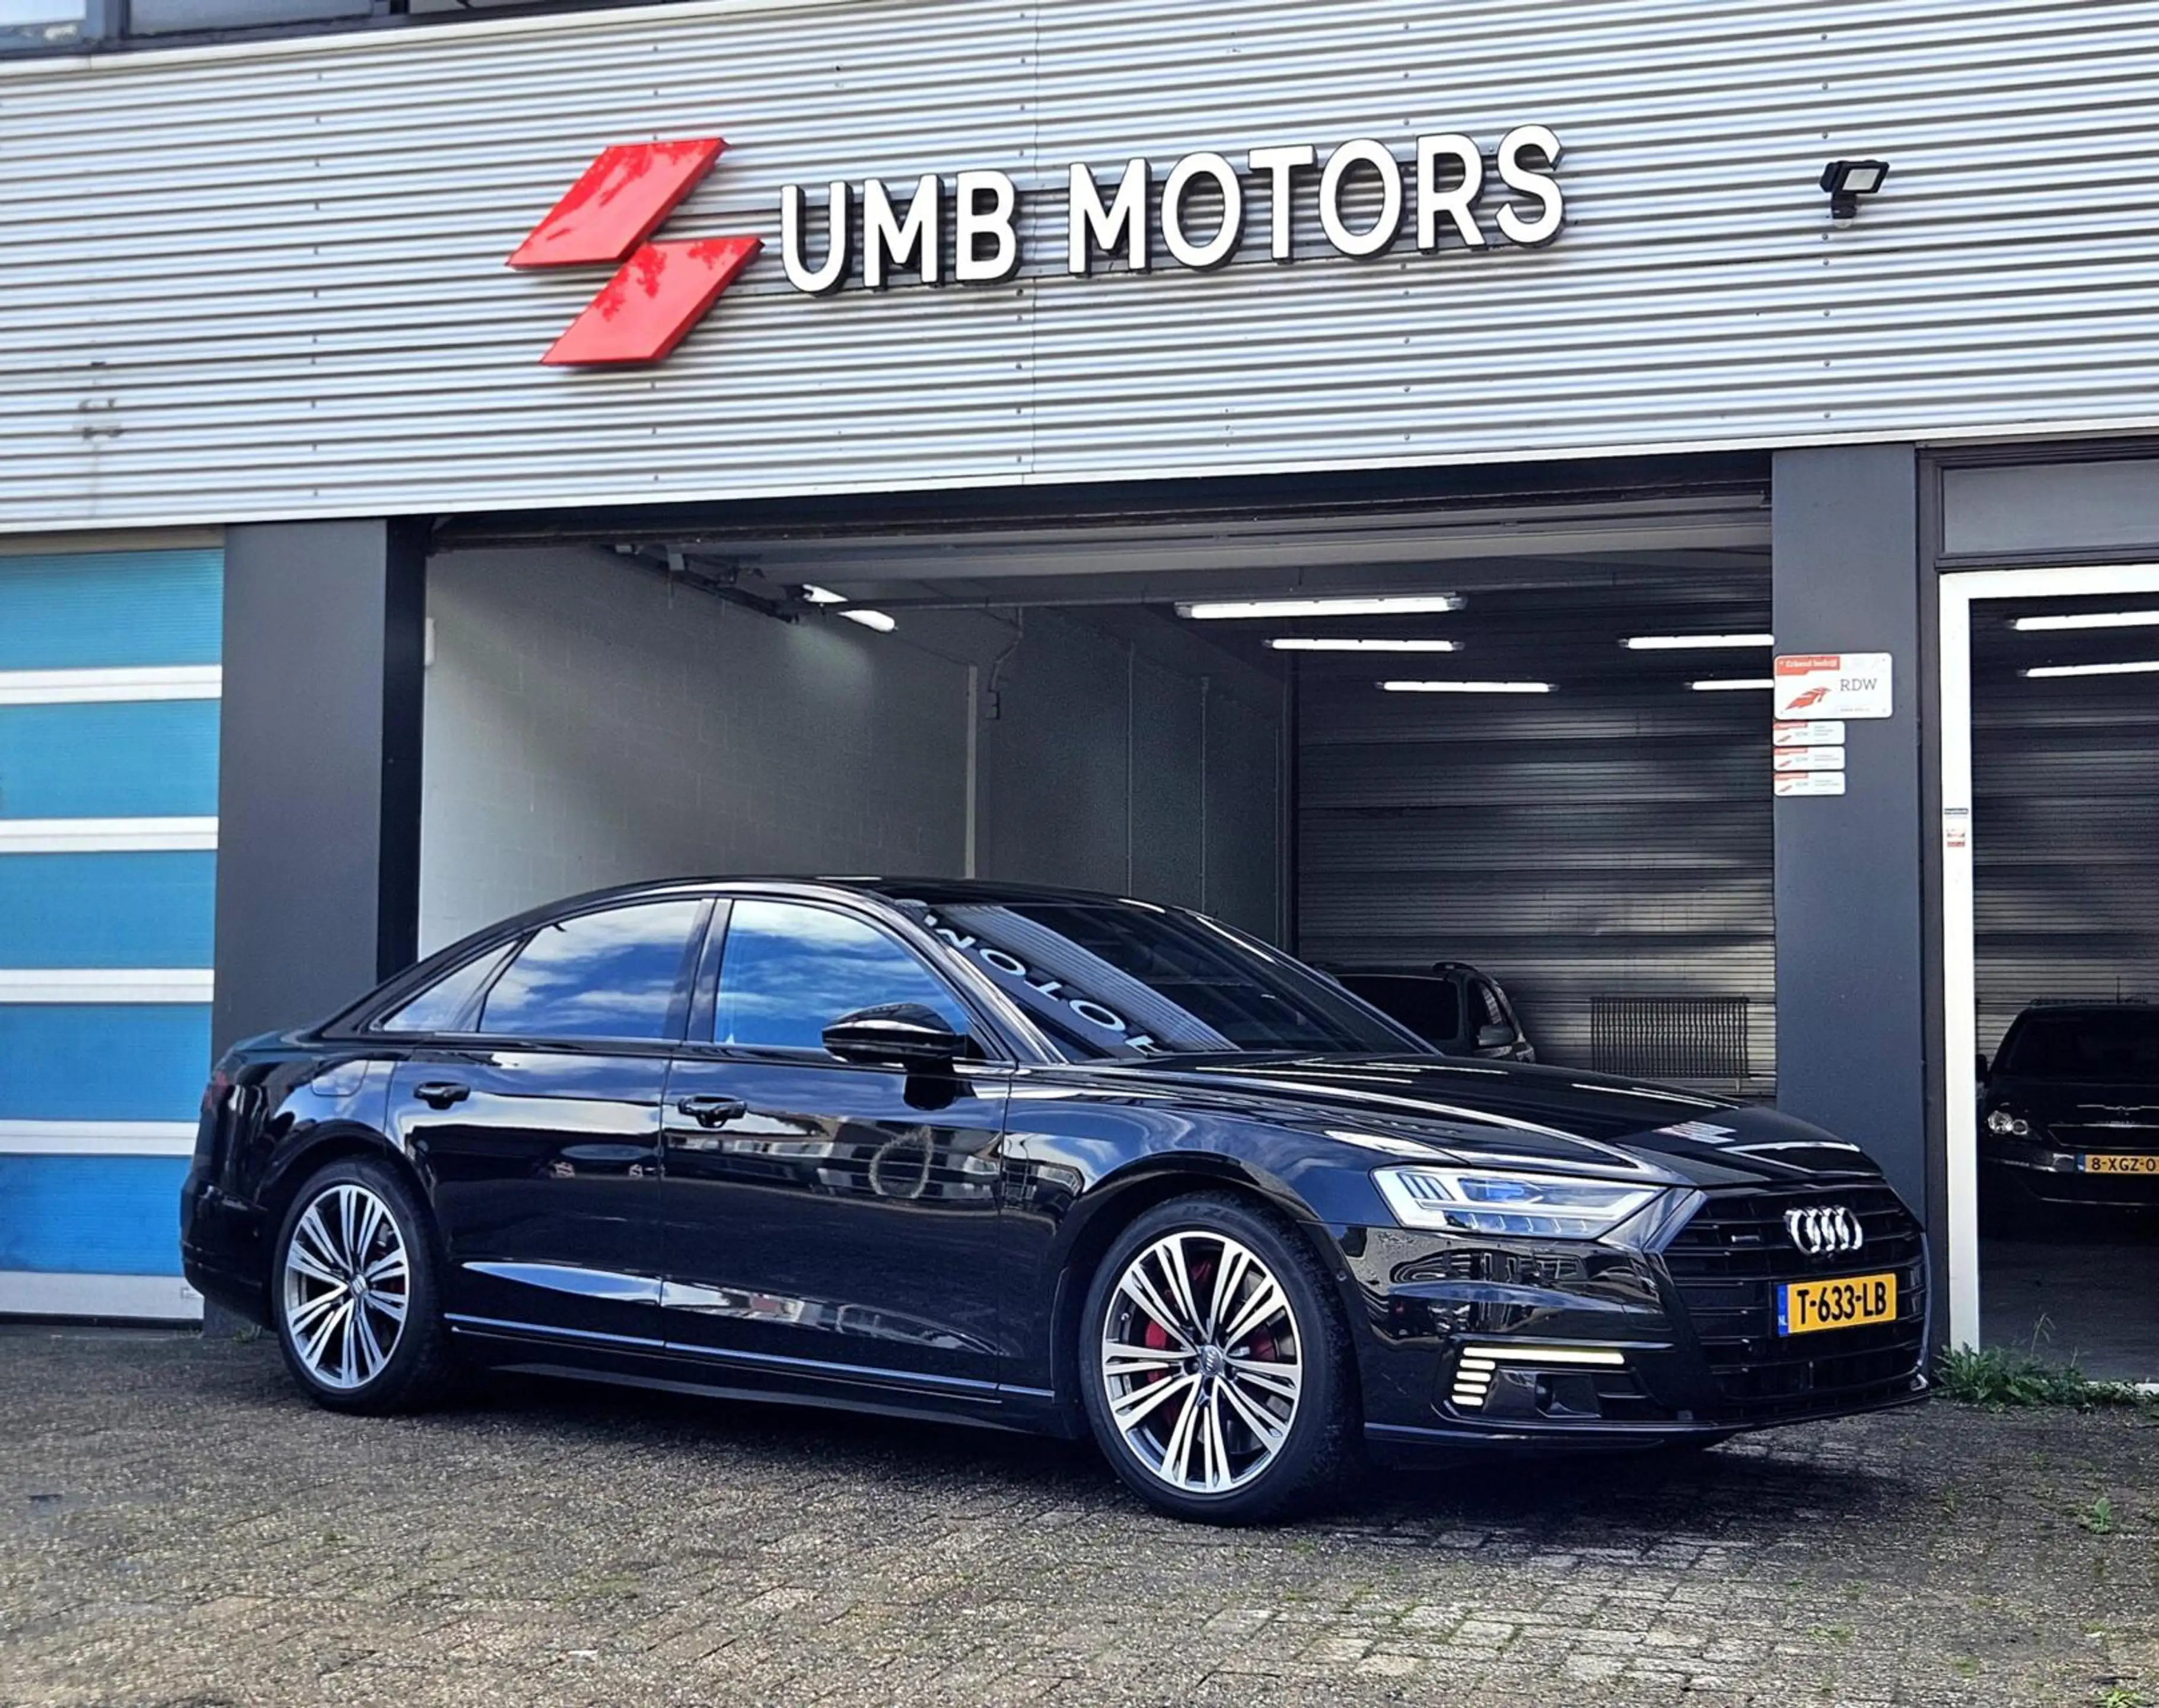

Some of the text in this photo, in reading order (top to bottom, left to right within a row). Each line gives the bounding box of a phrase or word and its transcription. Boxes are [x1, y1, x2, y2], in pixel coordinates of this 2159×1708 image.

[781, 124, 1565, 294] UMB MOTORS
[1840, 678, 1877, 692] RDW
[1796, 1281, 1887, 1325] T-633-LB
